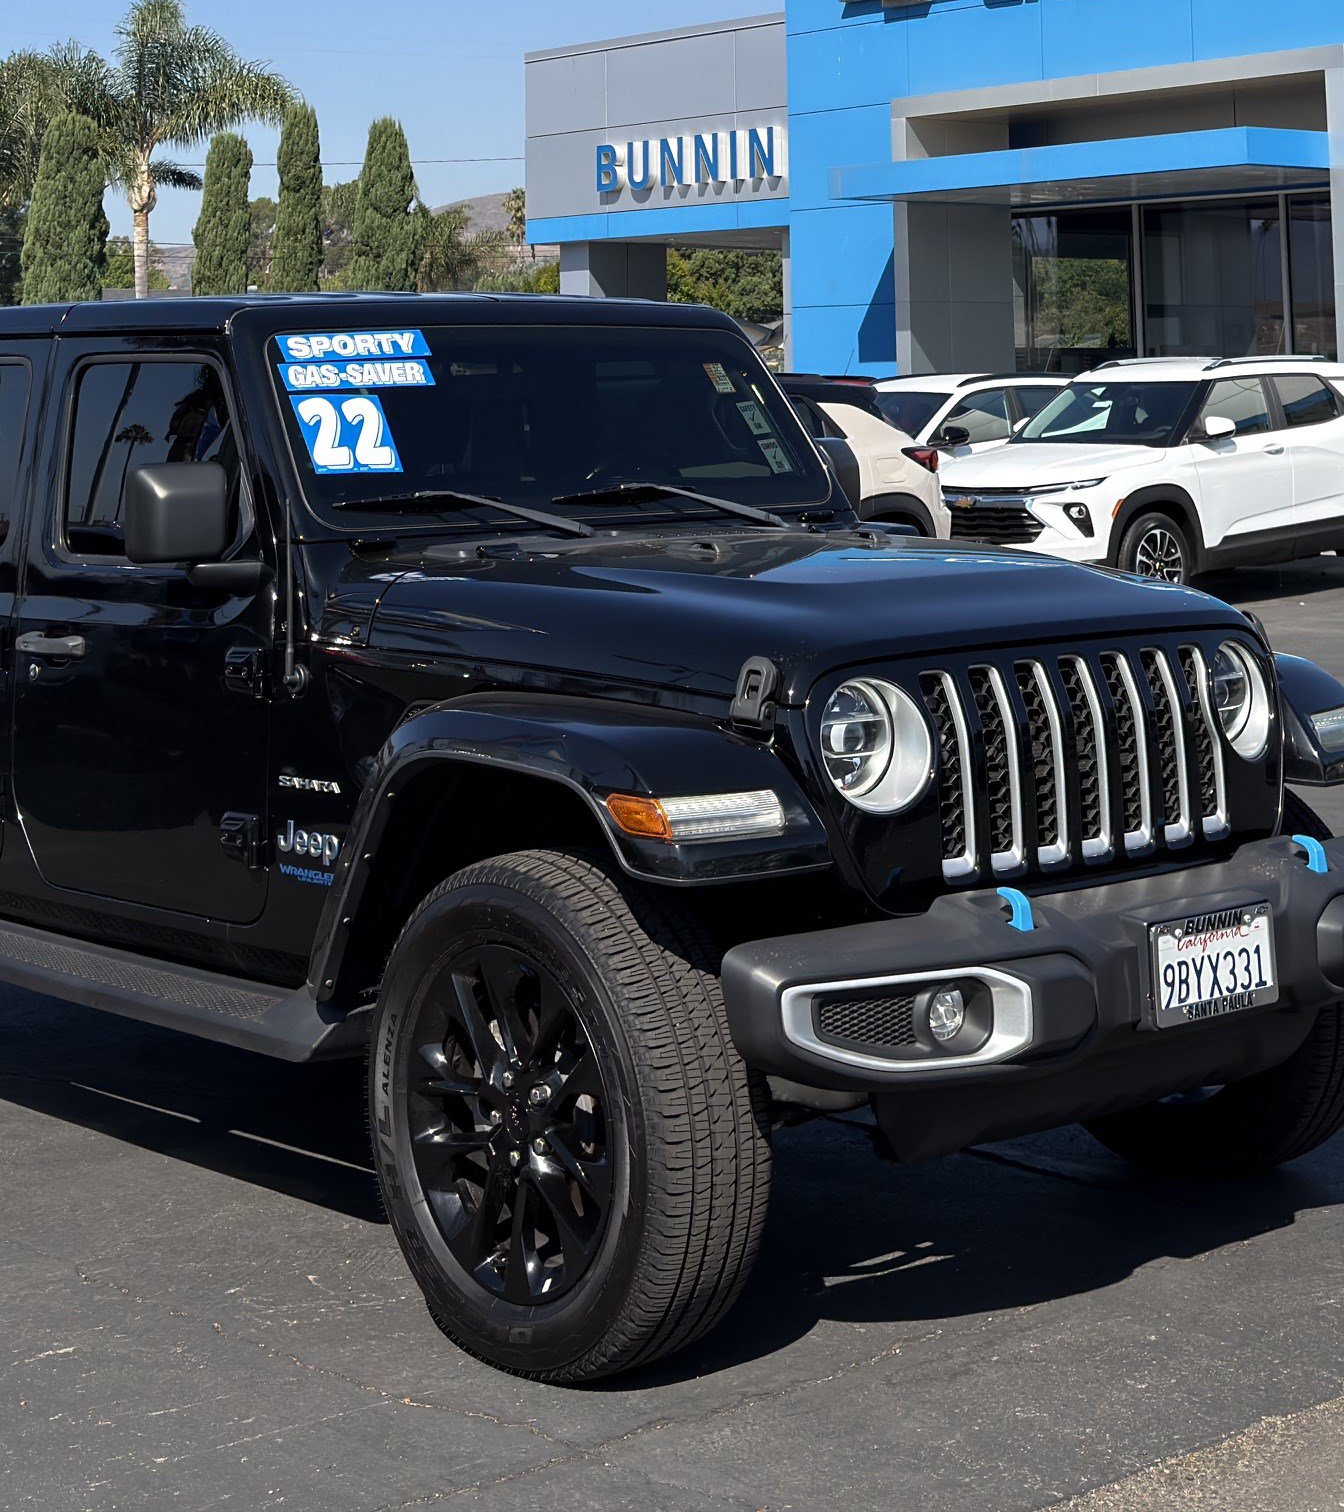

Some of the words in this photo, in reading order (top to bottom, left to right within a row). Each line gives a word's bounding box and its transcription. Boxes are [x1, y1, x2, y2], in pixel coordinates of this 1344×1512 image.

[596, 126, 780, 193] BUNNIN
[286, 333, 414, 359] SPORTY
[287, 363, 427, 388] GAS-SAVER
[297, 397, 395, 470] 22
[278, 775, 341, 794] SAHARA
[277, 819, 339, 866] Jeep
[1183, 910, 1244, 936] BUNNIN
[1177, 925, 1249, 953] California
[1163, 944, 1268, 1010] 9BYX331
[1187, 999, 1219, 1020] SANTA
[1222, 992, 1254, 1012] PAULA
[381, 1013, 399, 1097] ALENZA
